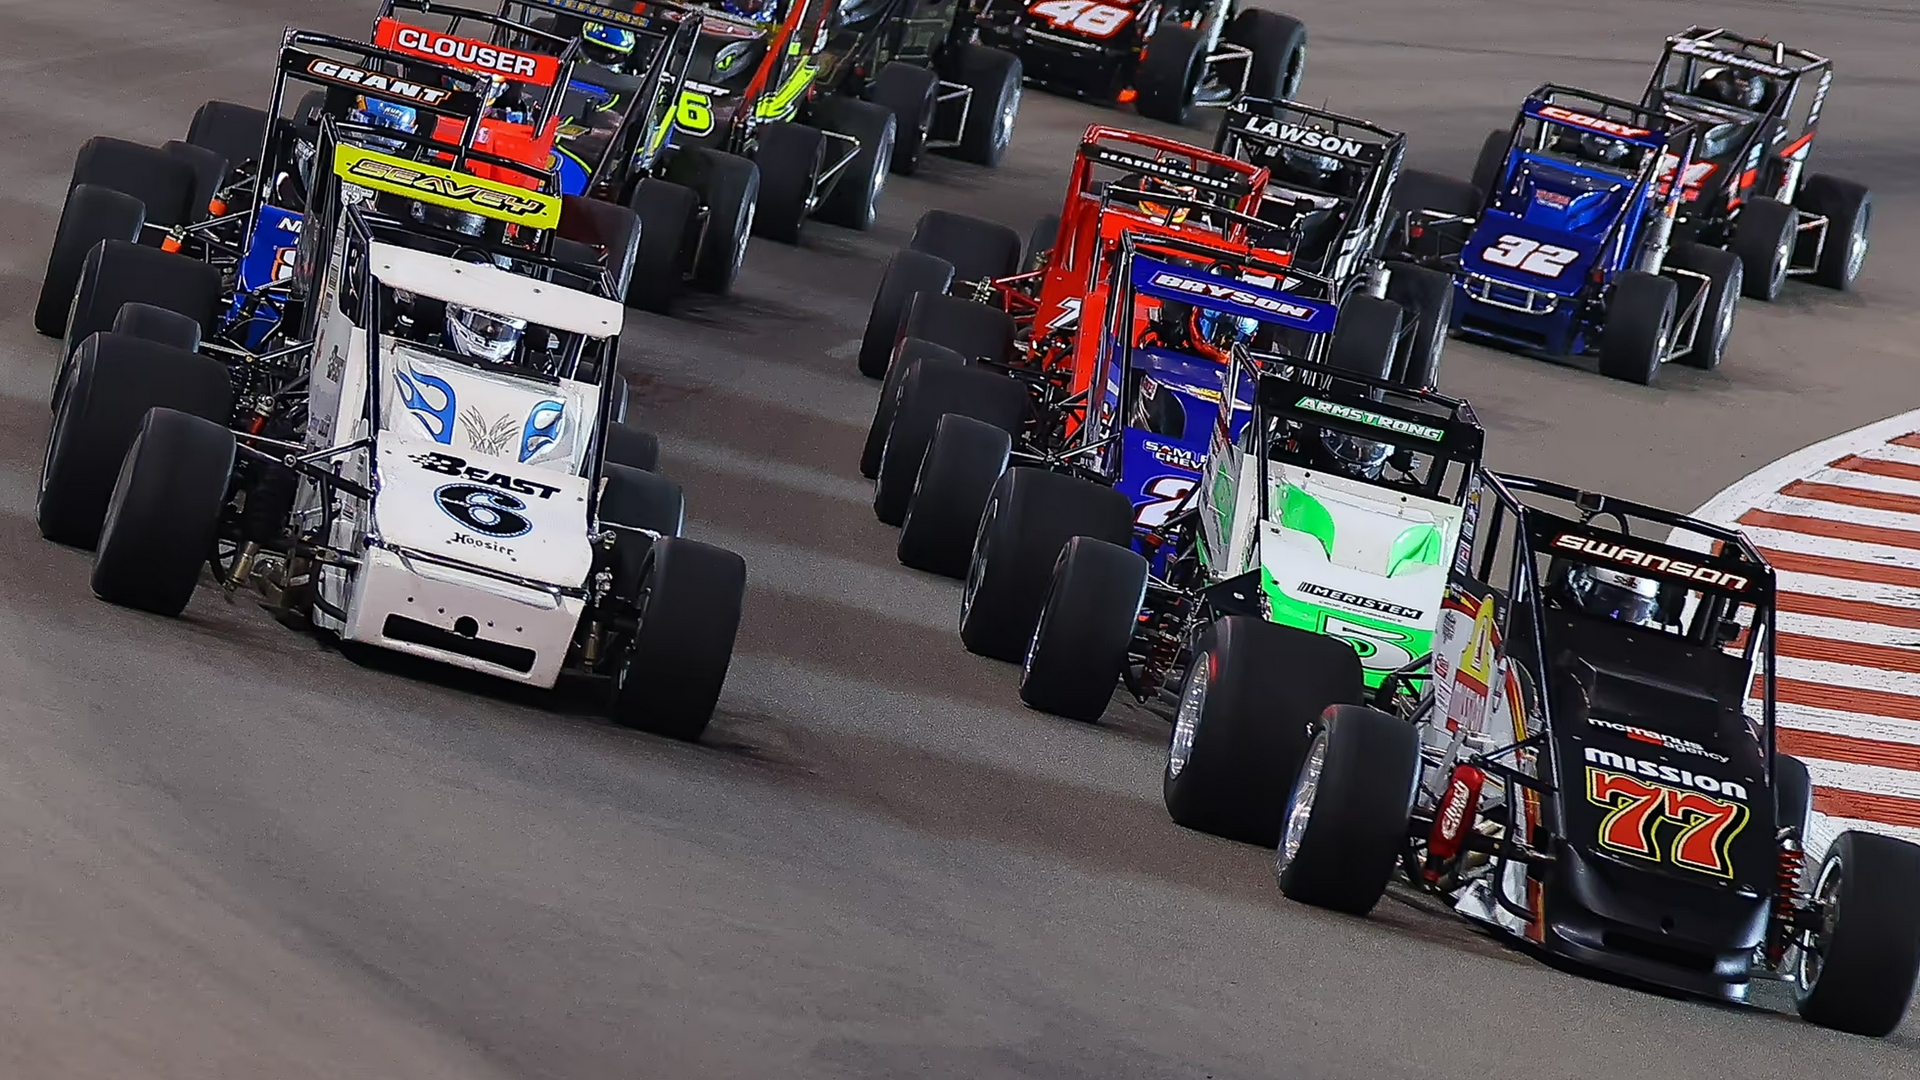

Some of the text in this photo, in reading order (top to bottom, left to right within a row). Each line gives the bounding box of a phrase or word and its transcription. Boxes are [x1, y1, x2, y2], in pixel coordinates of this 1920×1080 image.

[1029, 0, 1136, 39] 48
[397, 28, 537, 77] CLOUSER
[312, 60, 446, 103] GRANT
[676, 91, 713, 136] 6
[1244, 116, 1362, 158] LAWSON
[350, 158, 547, 217] SEAVEY
[1482, 234, 1580, 278] 32
[1154, 272, 1309, 318] BRYSON
[1300, 398, 1440, 439] ARMSTRONG
[1145, 441, 1192, 459] SAM
[407, 451, 562, 501] BEAST
[433, 482, 533, 539] 6
[450, 531, 516, 557] Hoosier
[1556, 534, 1749, 590] SWANSON
[1313, 586, 1420, 619] MERISTEM
[1323, 613, 1414, 672] 5
[1588, 717, 1704, 751] mcmanus
[1662, 741, 1730, 764] agency
[1584, 747, 1748, 801] mission
[1585, 765, 1750, 879] 77
